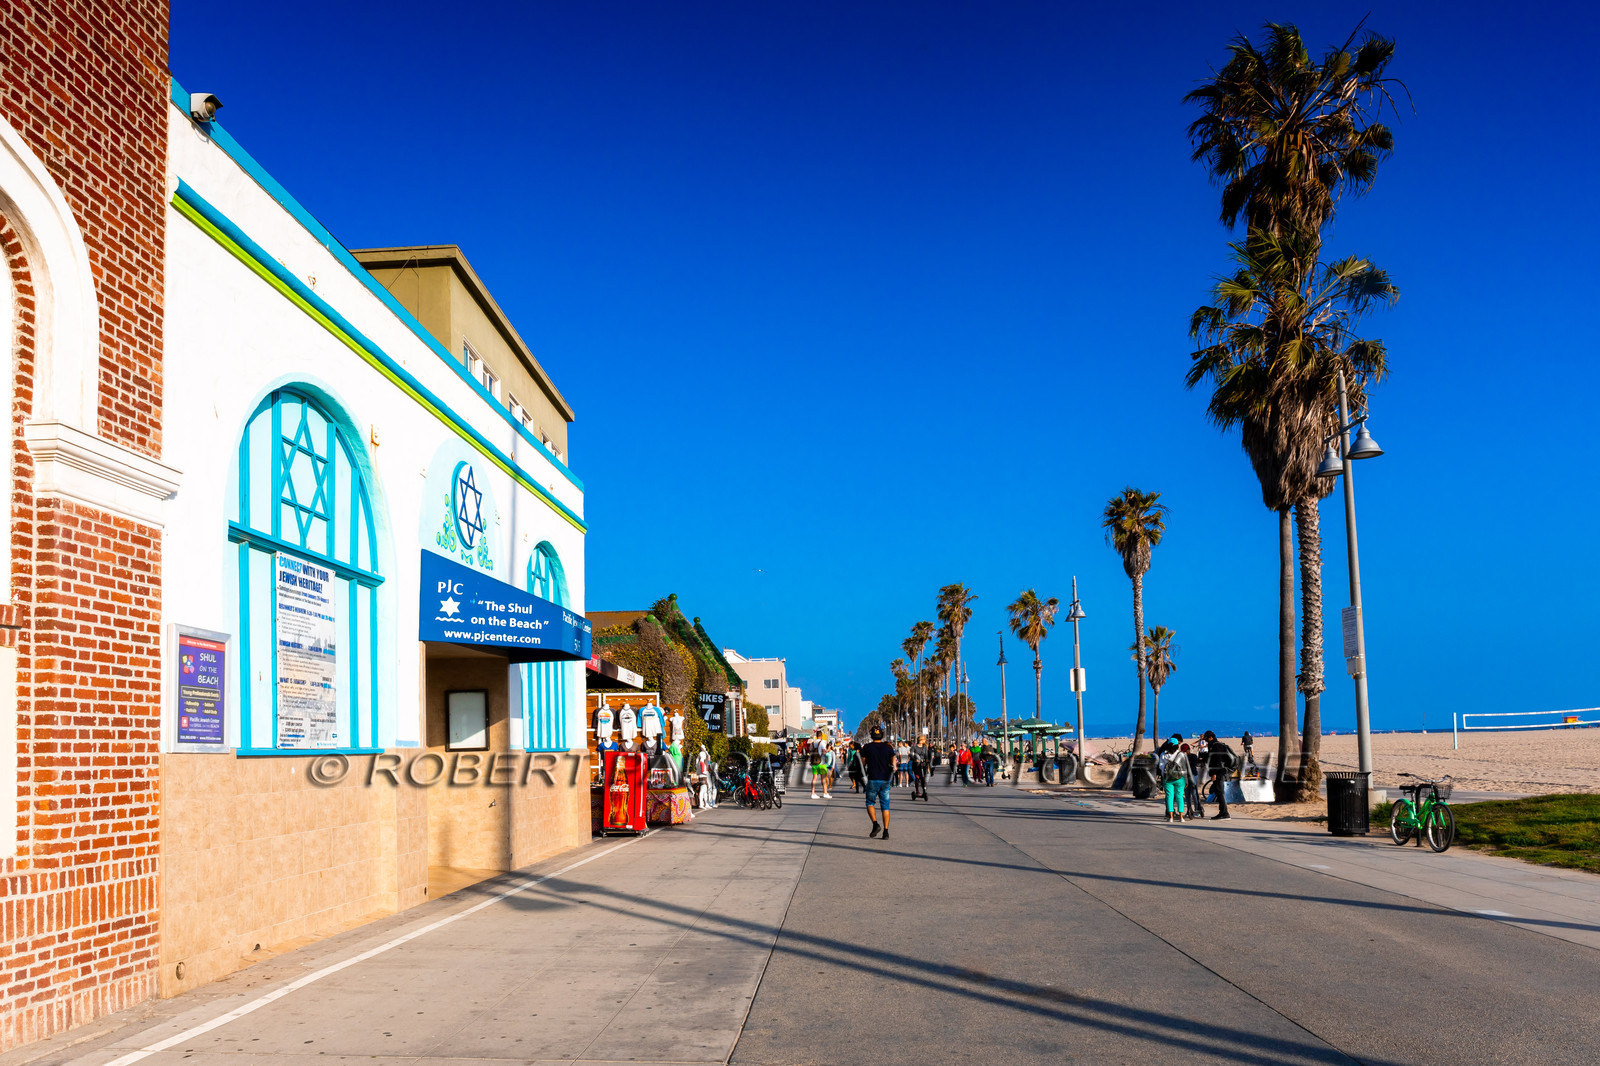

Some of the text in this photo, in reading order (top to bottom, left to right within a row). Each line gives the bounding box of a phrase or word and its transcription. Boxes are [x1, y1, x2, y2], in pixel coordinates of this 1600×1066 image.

[279, 556, 329, 582] CONNECT WITH YOUR
[278, 570, 298, 586] JEWISH
[298, 576, 323, 594] HERITAGE!
[438, 579, 464, 595] PJC
[508, 603, 533, 614] Shul
[471, 616, 485, 624] on
[488, 617, 506, 627] the
[563, 611, 591, 634] Pacific Jewish Center
[444, 630, 541, 644] www.pjcenter.com
[200, 653, 216, 663] SHUL
[198, 675, 218, 686] BEACH
